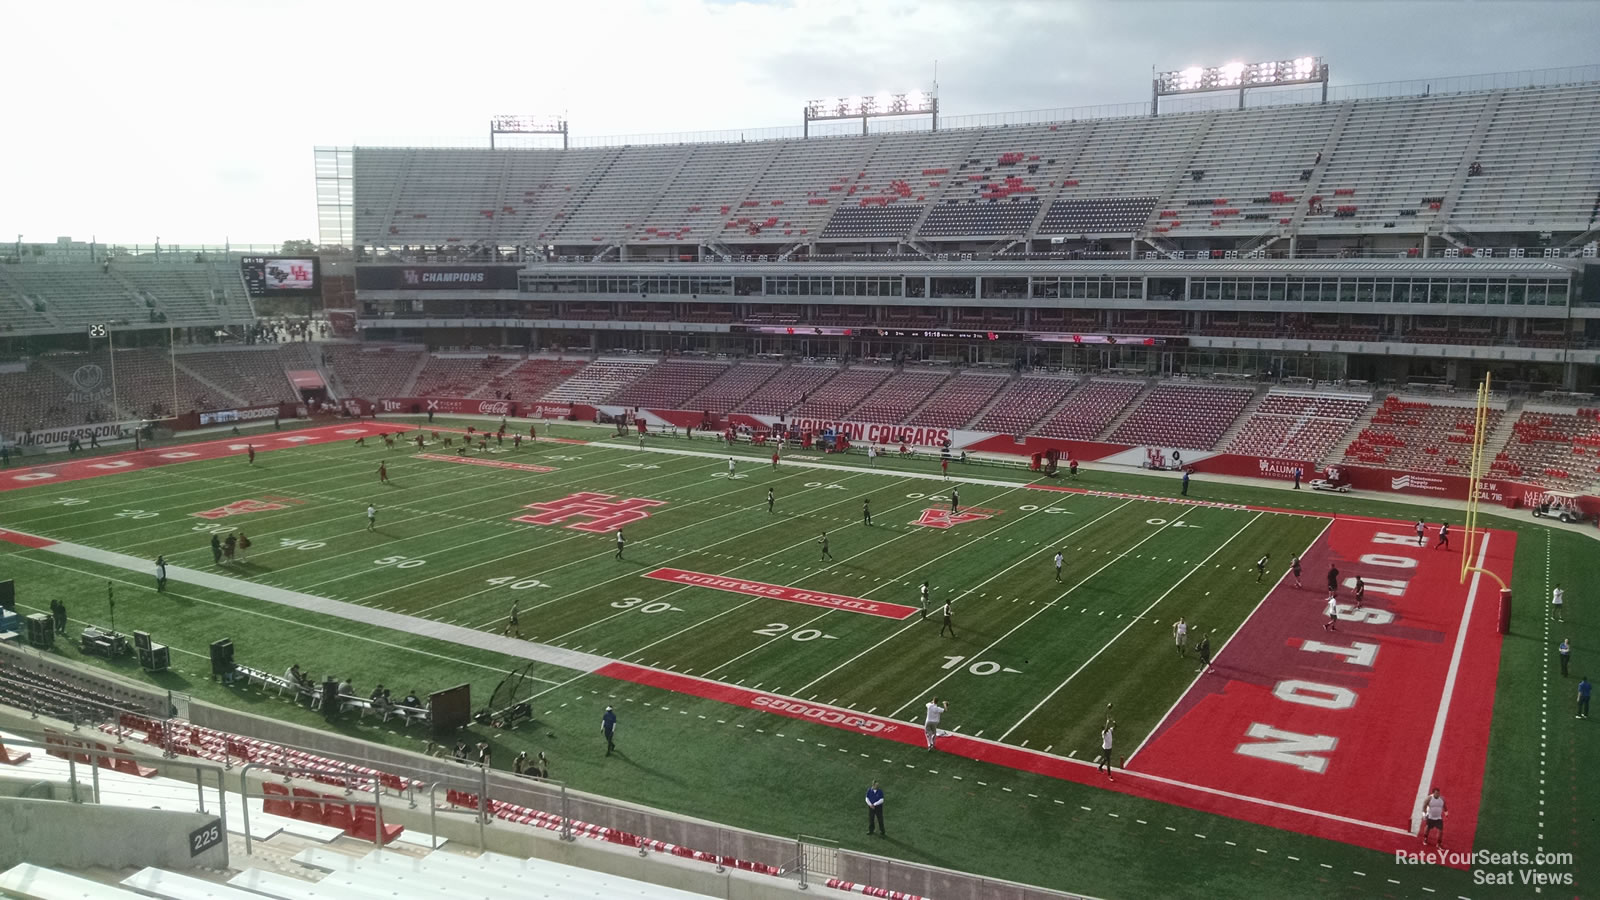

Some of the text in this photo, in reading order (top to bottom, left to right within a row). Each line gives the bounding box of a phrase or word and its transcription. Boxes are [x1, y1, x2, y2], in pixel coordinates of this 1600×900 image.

[422, 272, 485, 282] CHAMPIONS
[90, 324, 106, 336] 25
[384, 401, 401, 412] Lite
[868, 424, 951, 447] COUGARS
[373, 555, 426, 569] 50
[486, 575, 541, 590] 40
[674, 572, 880, 612] TDECU STADIUM
[611, 597, 672, 614] 30
[752, 623, 822, 642] 20
[941, 655, 1001, 676] 10
[194, 826, 219, 850] 225
